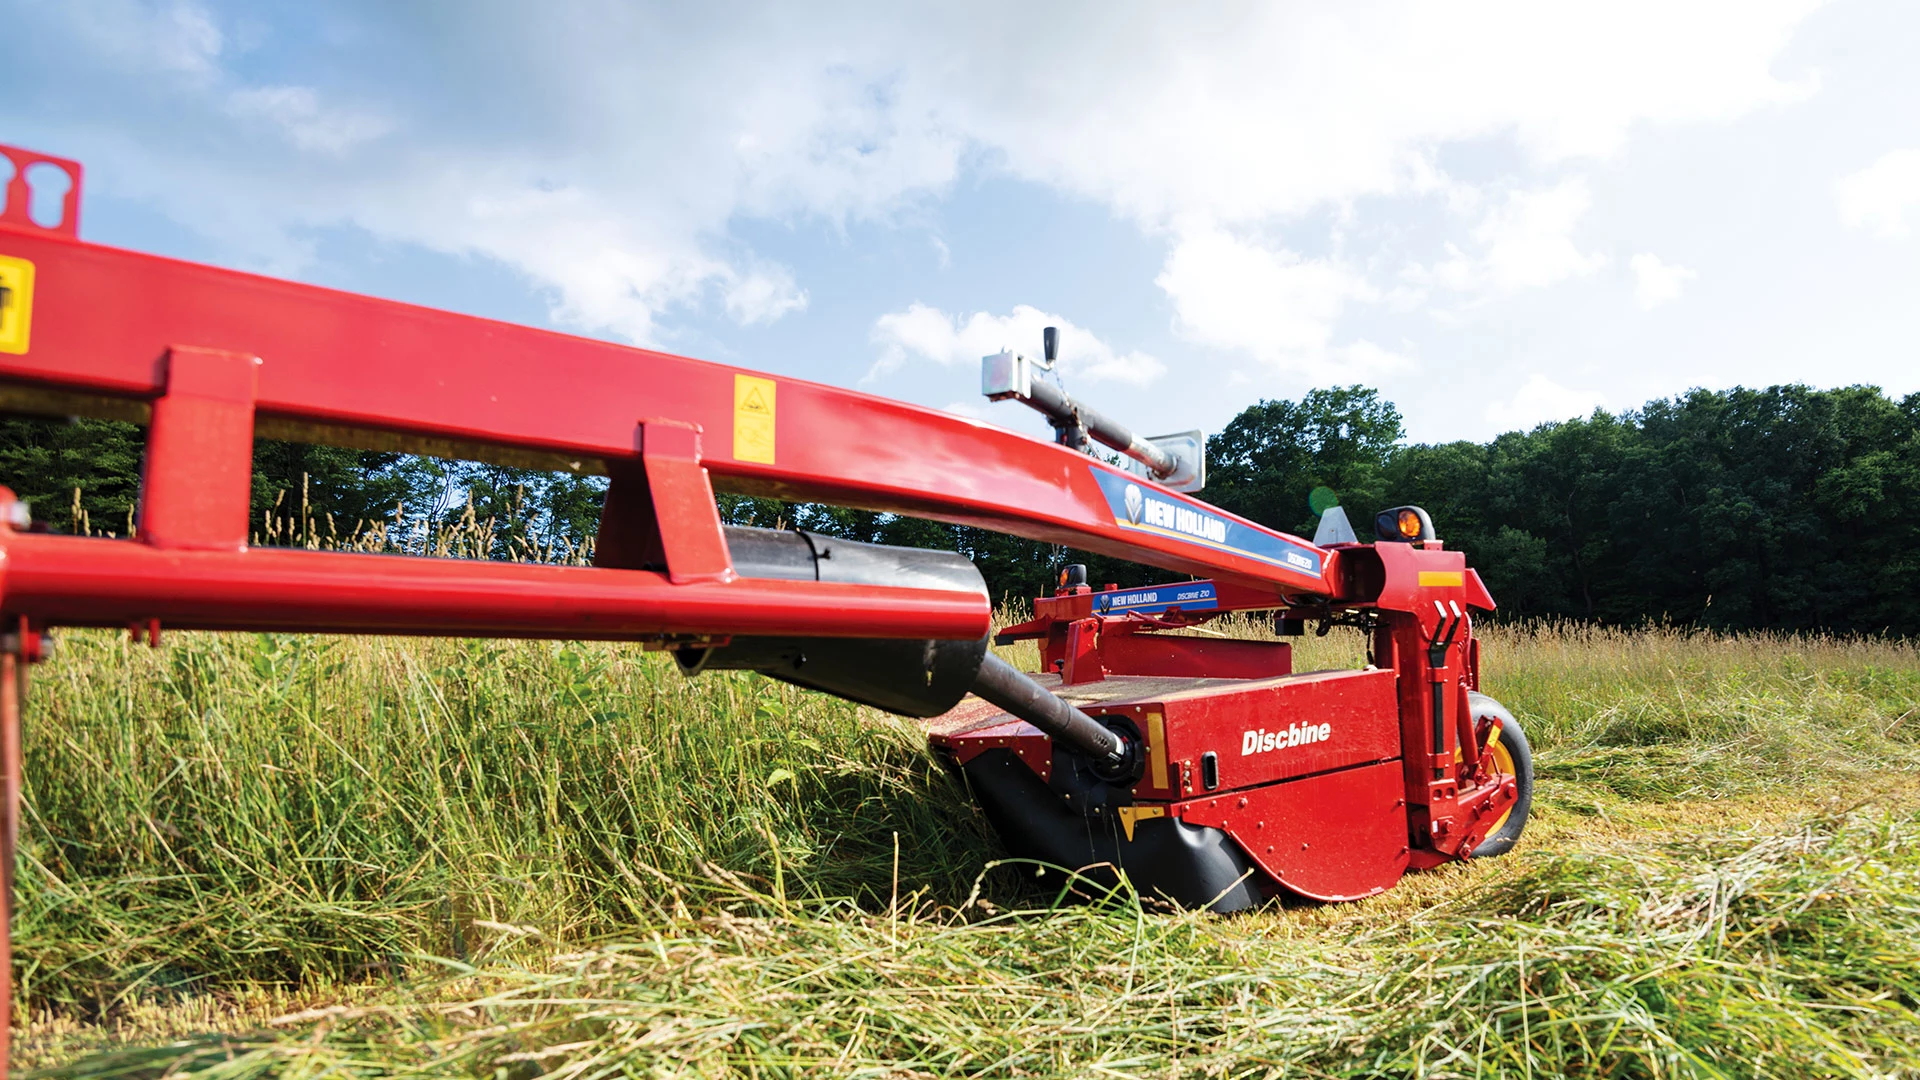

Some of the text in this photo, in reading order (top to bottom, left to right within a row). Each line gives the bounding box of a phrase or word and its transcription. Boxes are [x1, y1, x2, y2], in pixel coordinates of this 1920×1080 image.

[1145, 497, 1226, 543] NEW HOLLAND
[1112, 595, 1126, 606] NEW
[1127, 592, 1158, 605] HOLLAND
[1241, 721, 1331, 756] Discbine
